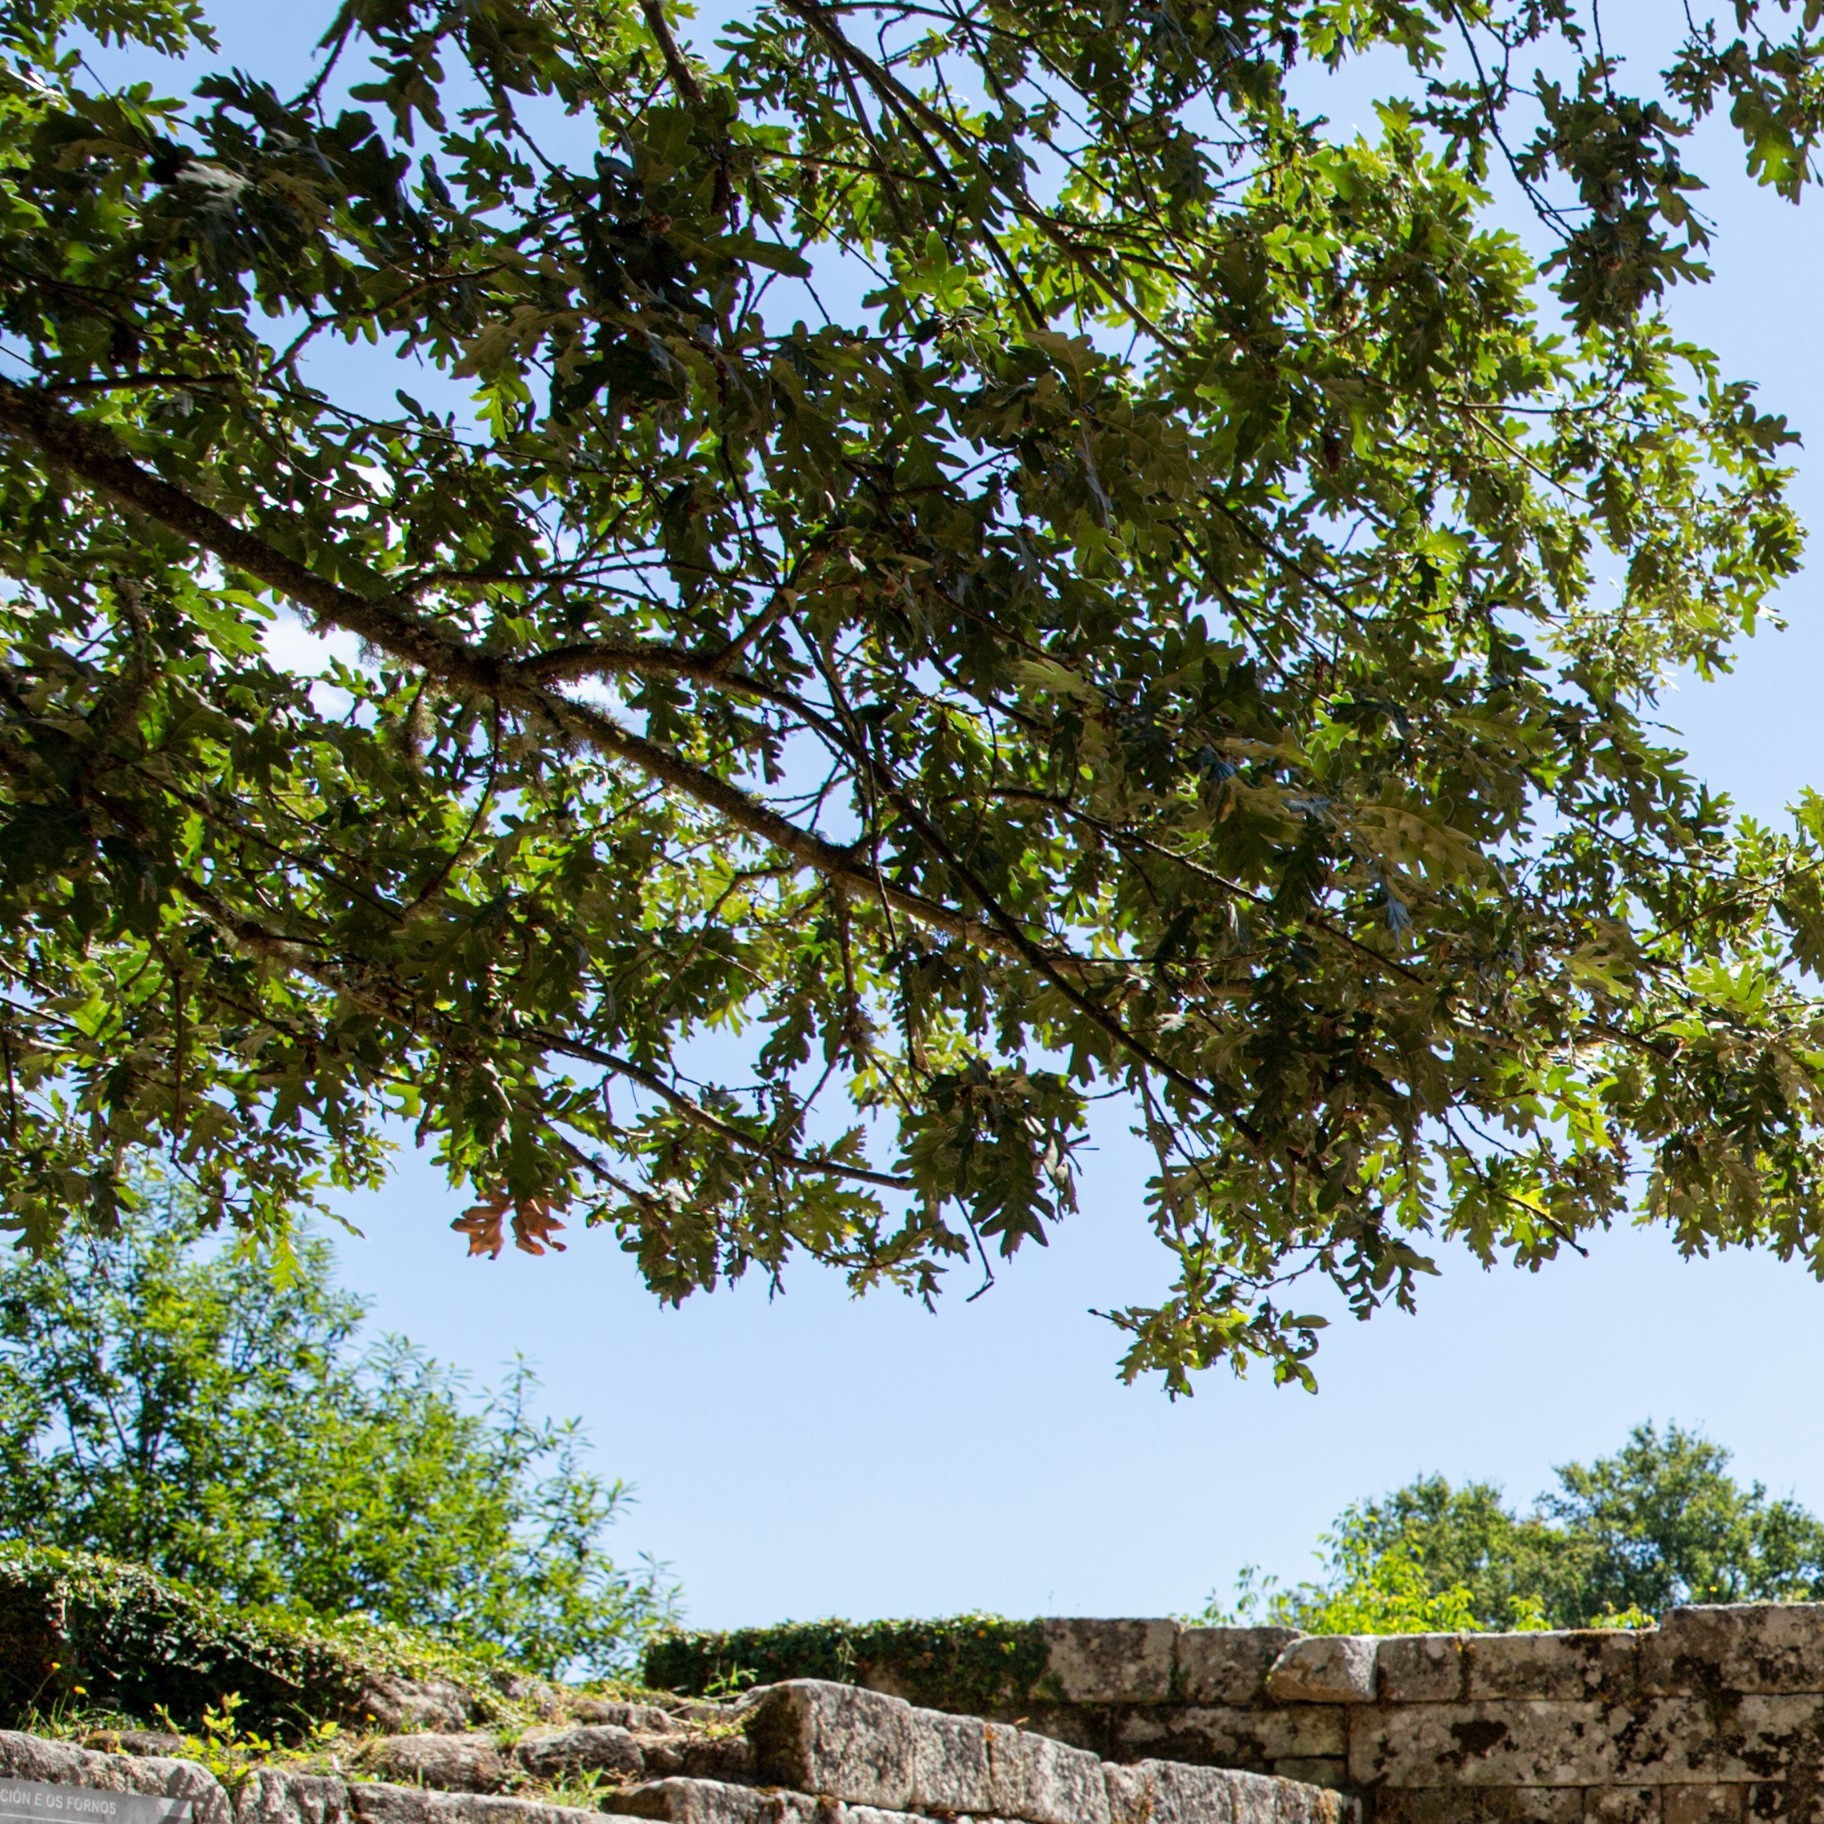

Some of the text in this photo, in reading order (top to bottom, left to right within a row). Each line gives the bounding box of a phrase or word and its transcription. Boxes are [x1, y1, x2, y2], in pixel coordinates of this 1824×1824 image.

[0, 1787, 117, 1815] CIÓN E OS FORNOS
